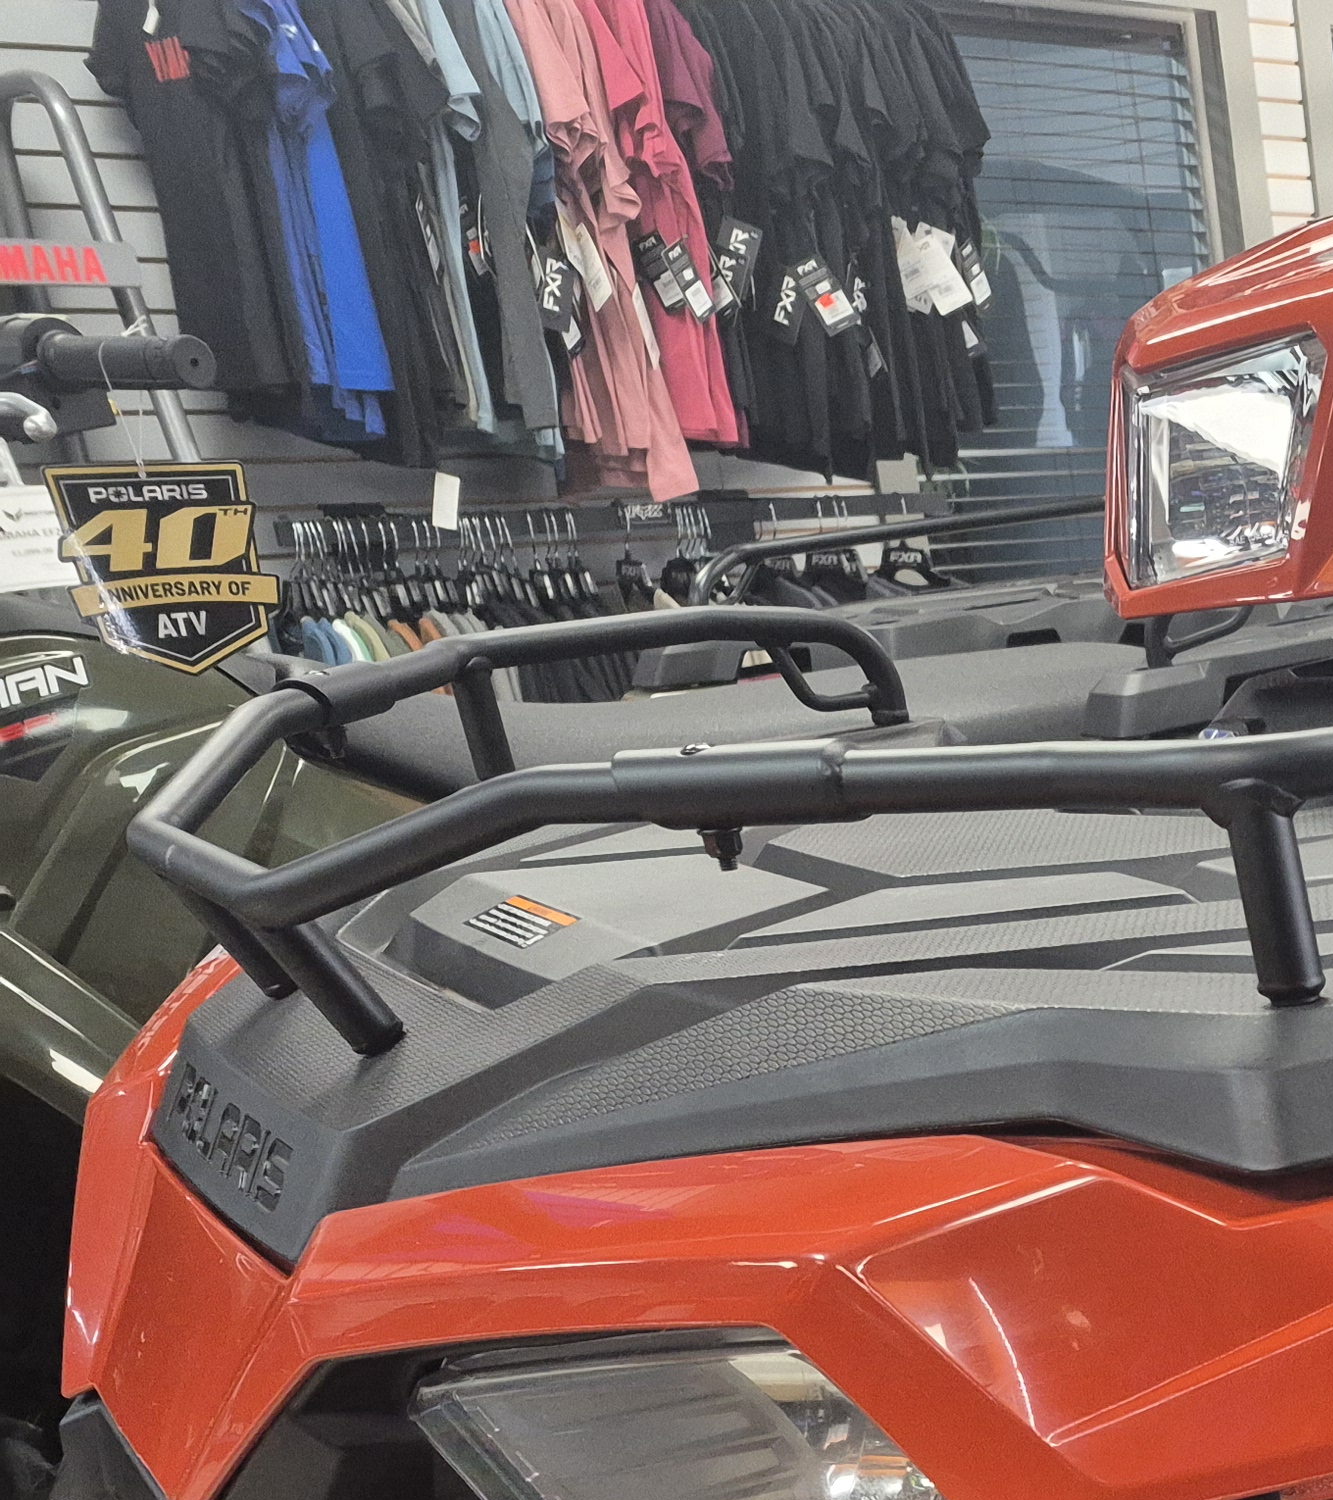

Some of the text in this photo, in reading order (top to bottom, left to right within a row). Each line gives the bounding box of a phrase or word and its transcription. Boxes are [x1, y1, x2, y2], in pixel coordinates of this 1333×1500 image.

[728, 226, 750, 255] XR
[543, 257, 569, 313] FXR
[773, 274, 796, 327] FXR
[87, 483, 209, 504] POLARIS
[104, 580, 252, 605] NNIVERSARY OF
[157, 610, 207, 639] ATV
[0, 656, 89, 709] AN
